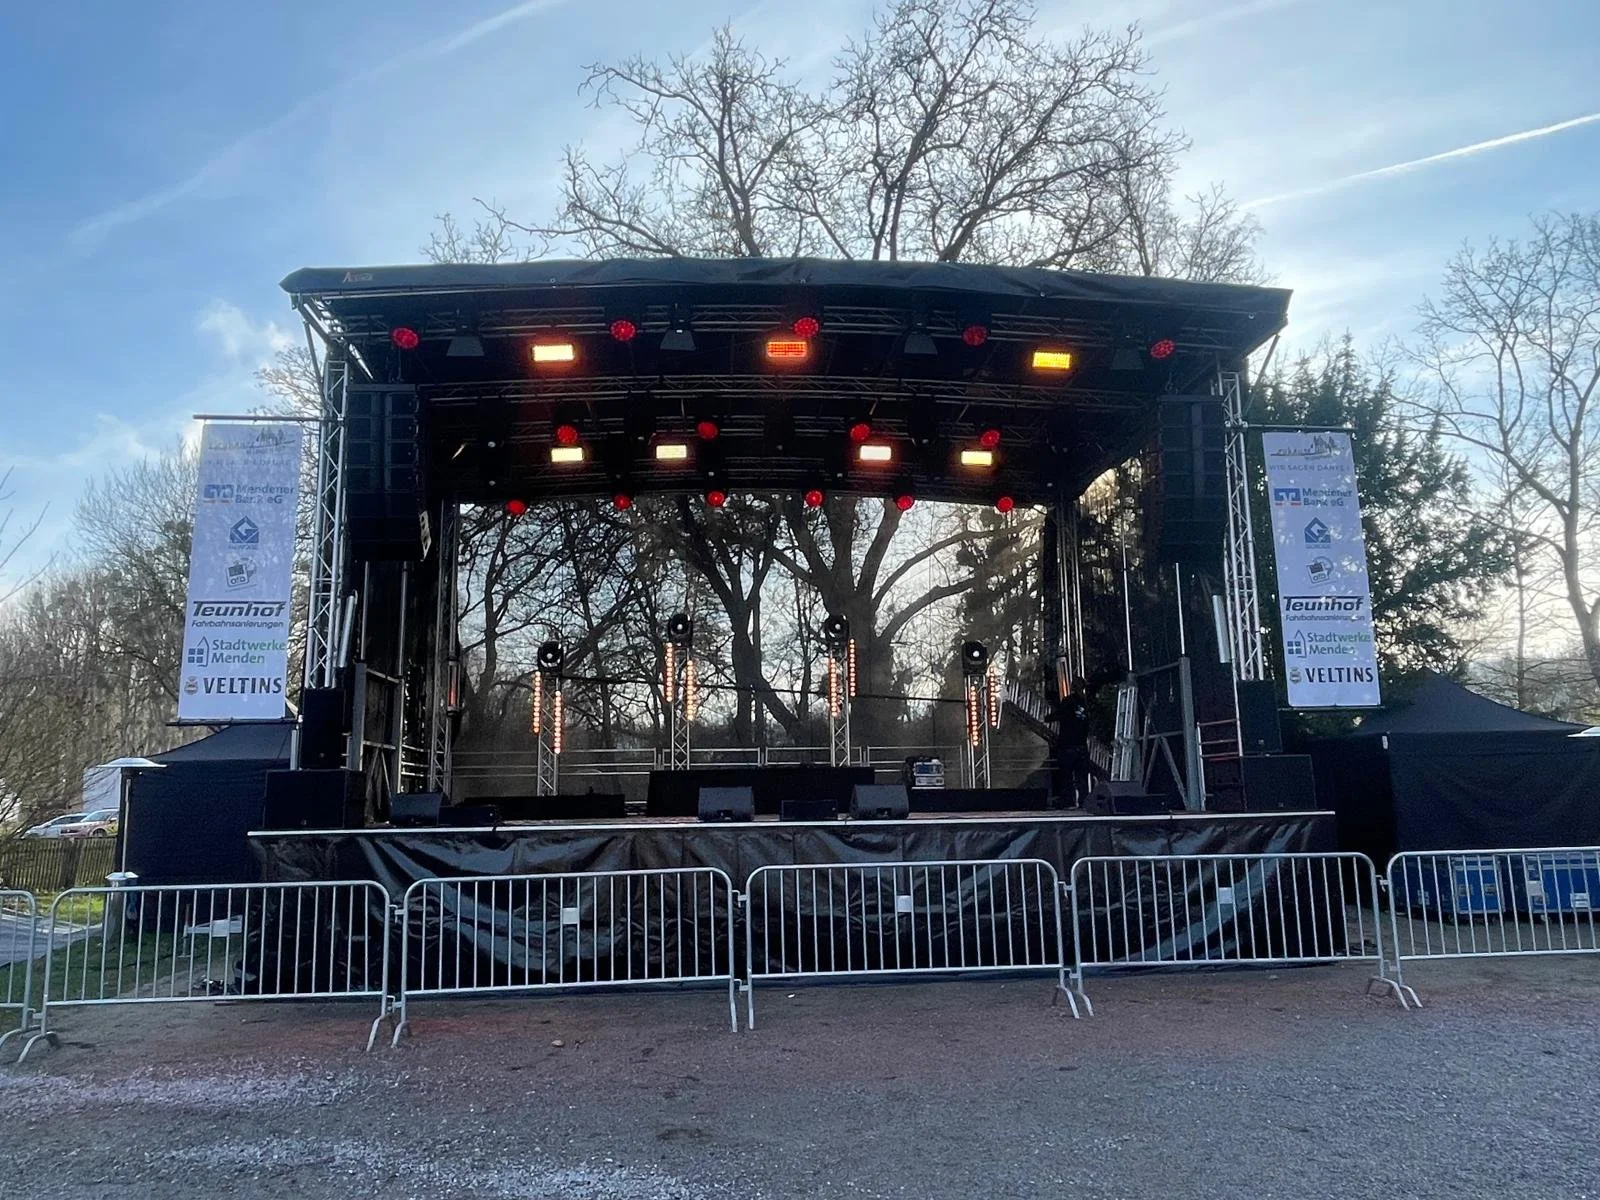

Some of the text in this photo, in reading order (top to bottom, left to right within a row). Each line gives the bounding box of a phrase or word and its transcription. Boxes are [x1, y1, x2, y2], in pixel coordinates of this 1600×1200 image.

[236, 484, 295, 494] Mendener
[1302, 488, 1353, 497] Mendener
[267, 495, 283, 504] eG
[193, 601, 286, 617] Teunhof
[1283, 596, 1364, 611] Teunhof
[191, 620, 284, 629] Fahrbahnsanierungen
[1308, 632, 1371, 642] Stadtwerke
[212, 639, 286, 651] Stadtwerke
[211, 652, 265, 663] Menden
[1305, 667, 1374, 683] VELTINS
[203, 677, 282, 694] VELTINS
